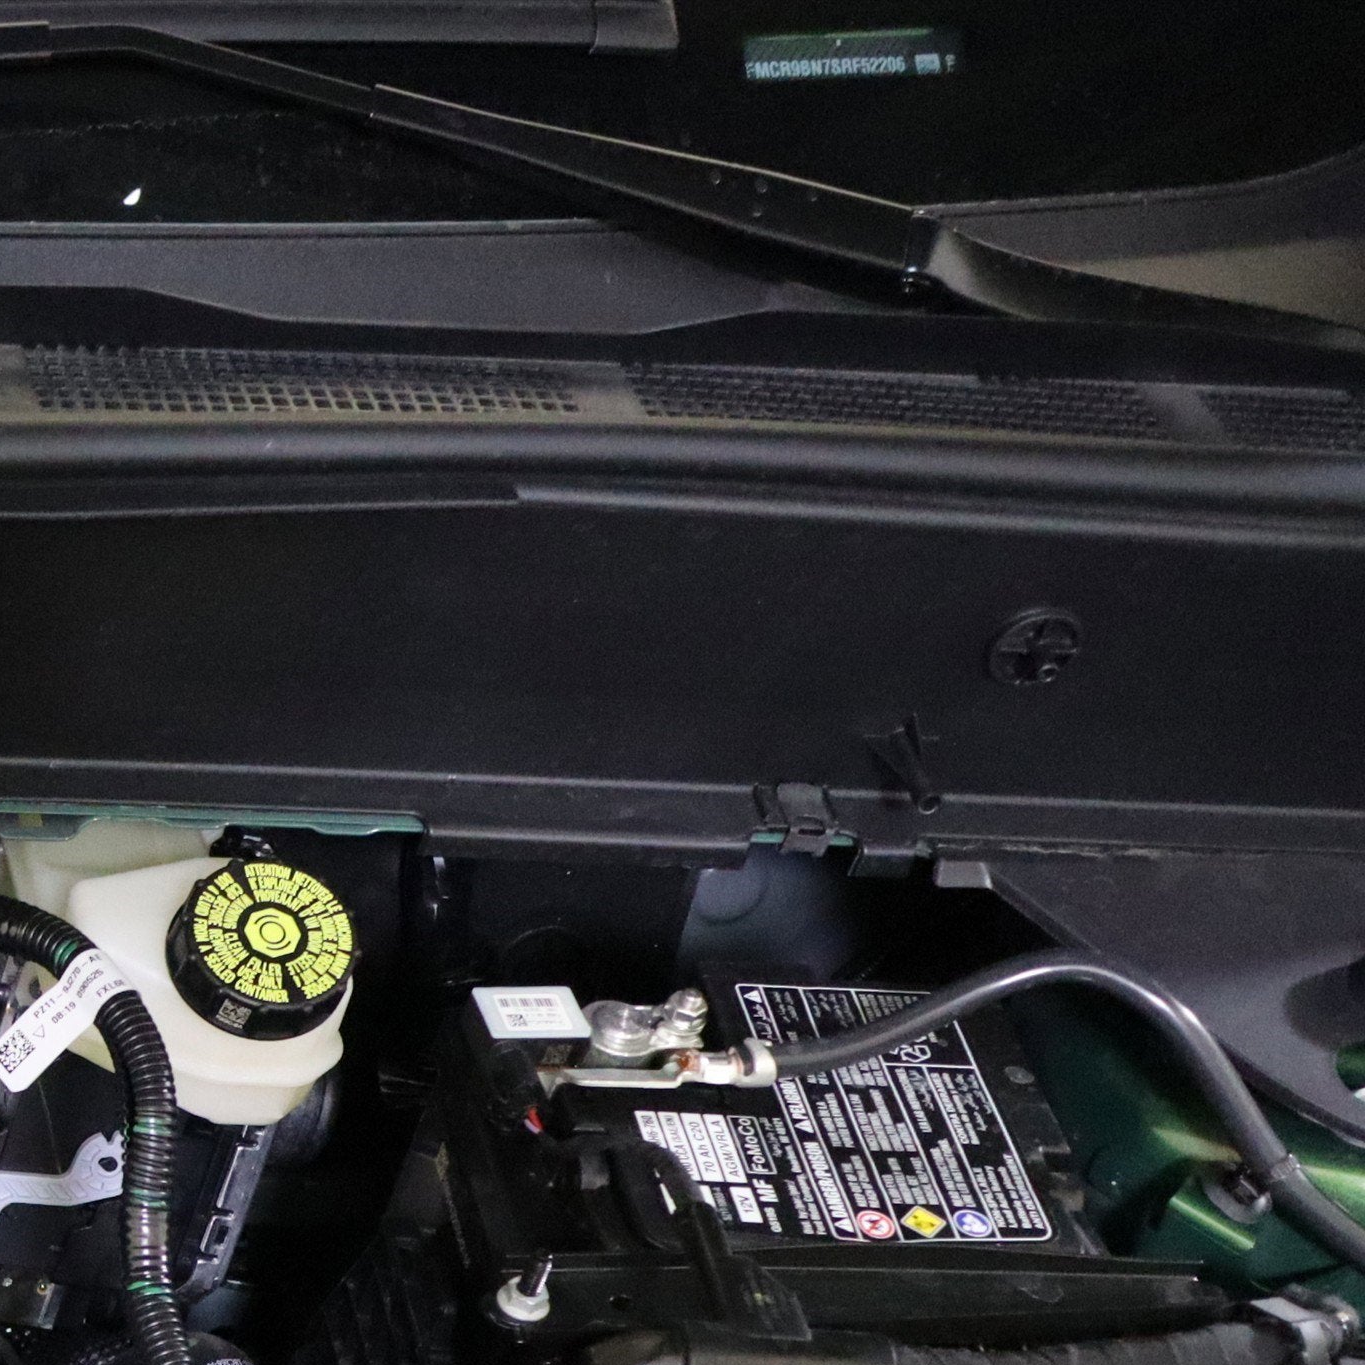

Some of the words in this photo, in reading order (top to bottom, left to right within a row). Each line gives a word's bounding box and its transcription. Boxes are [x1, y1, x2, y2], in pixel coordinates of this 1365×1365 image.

[709, 1120, 741, 1177] AGM/VRLA
[730, 1117, 769, 1171] FoMoCo
[737, 1194, 754, 1212] 12V
[751, 1178, 779, 1202] MF
[801, 1141, 849, 1218] DANGER/POISON
